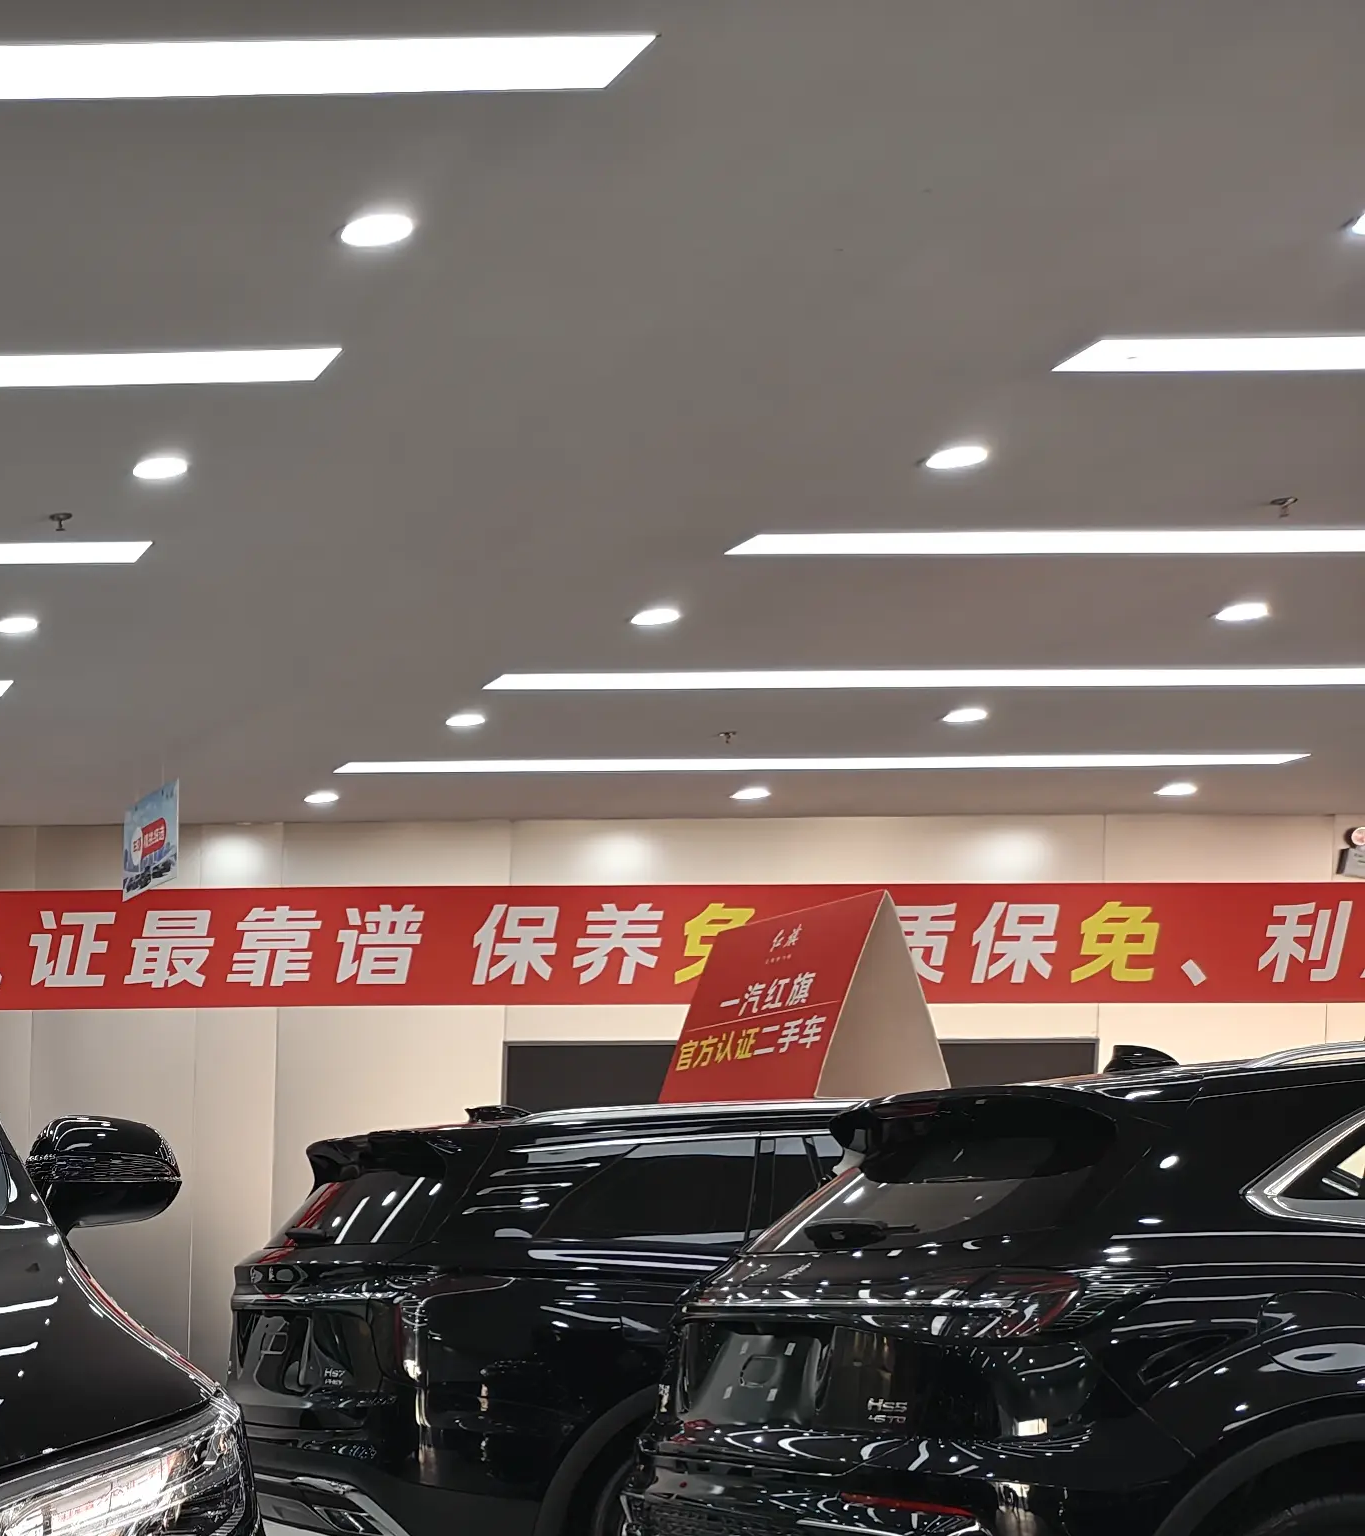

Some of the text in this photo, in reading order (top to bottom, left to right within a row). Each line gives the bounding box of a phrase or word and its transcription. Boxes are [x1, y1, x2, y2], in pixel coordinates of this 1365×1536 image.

[720, 971, 816, 1017] 一汽红旗
[675, 1014, 827, 1072] 官方认证二手车
[867, 1397, 908, 1412] HS5
